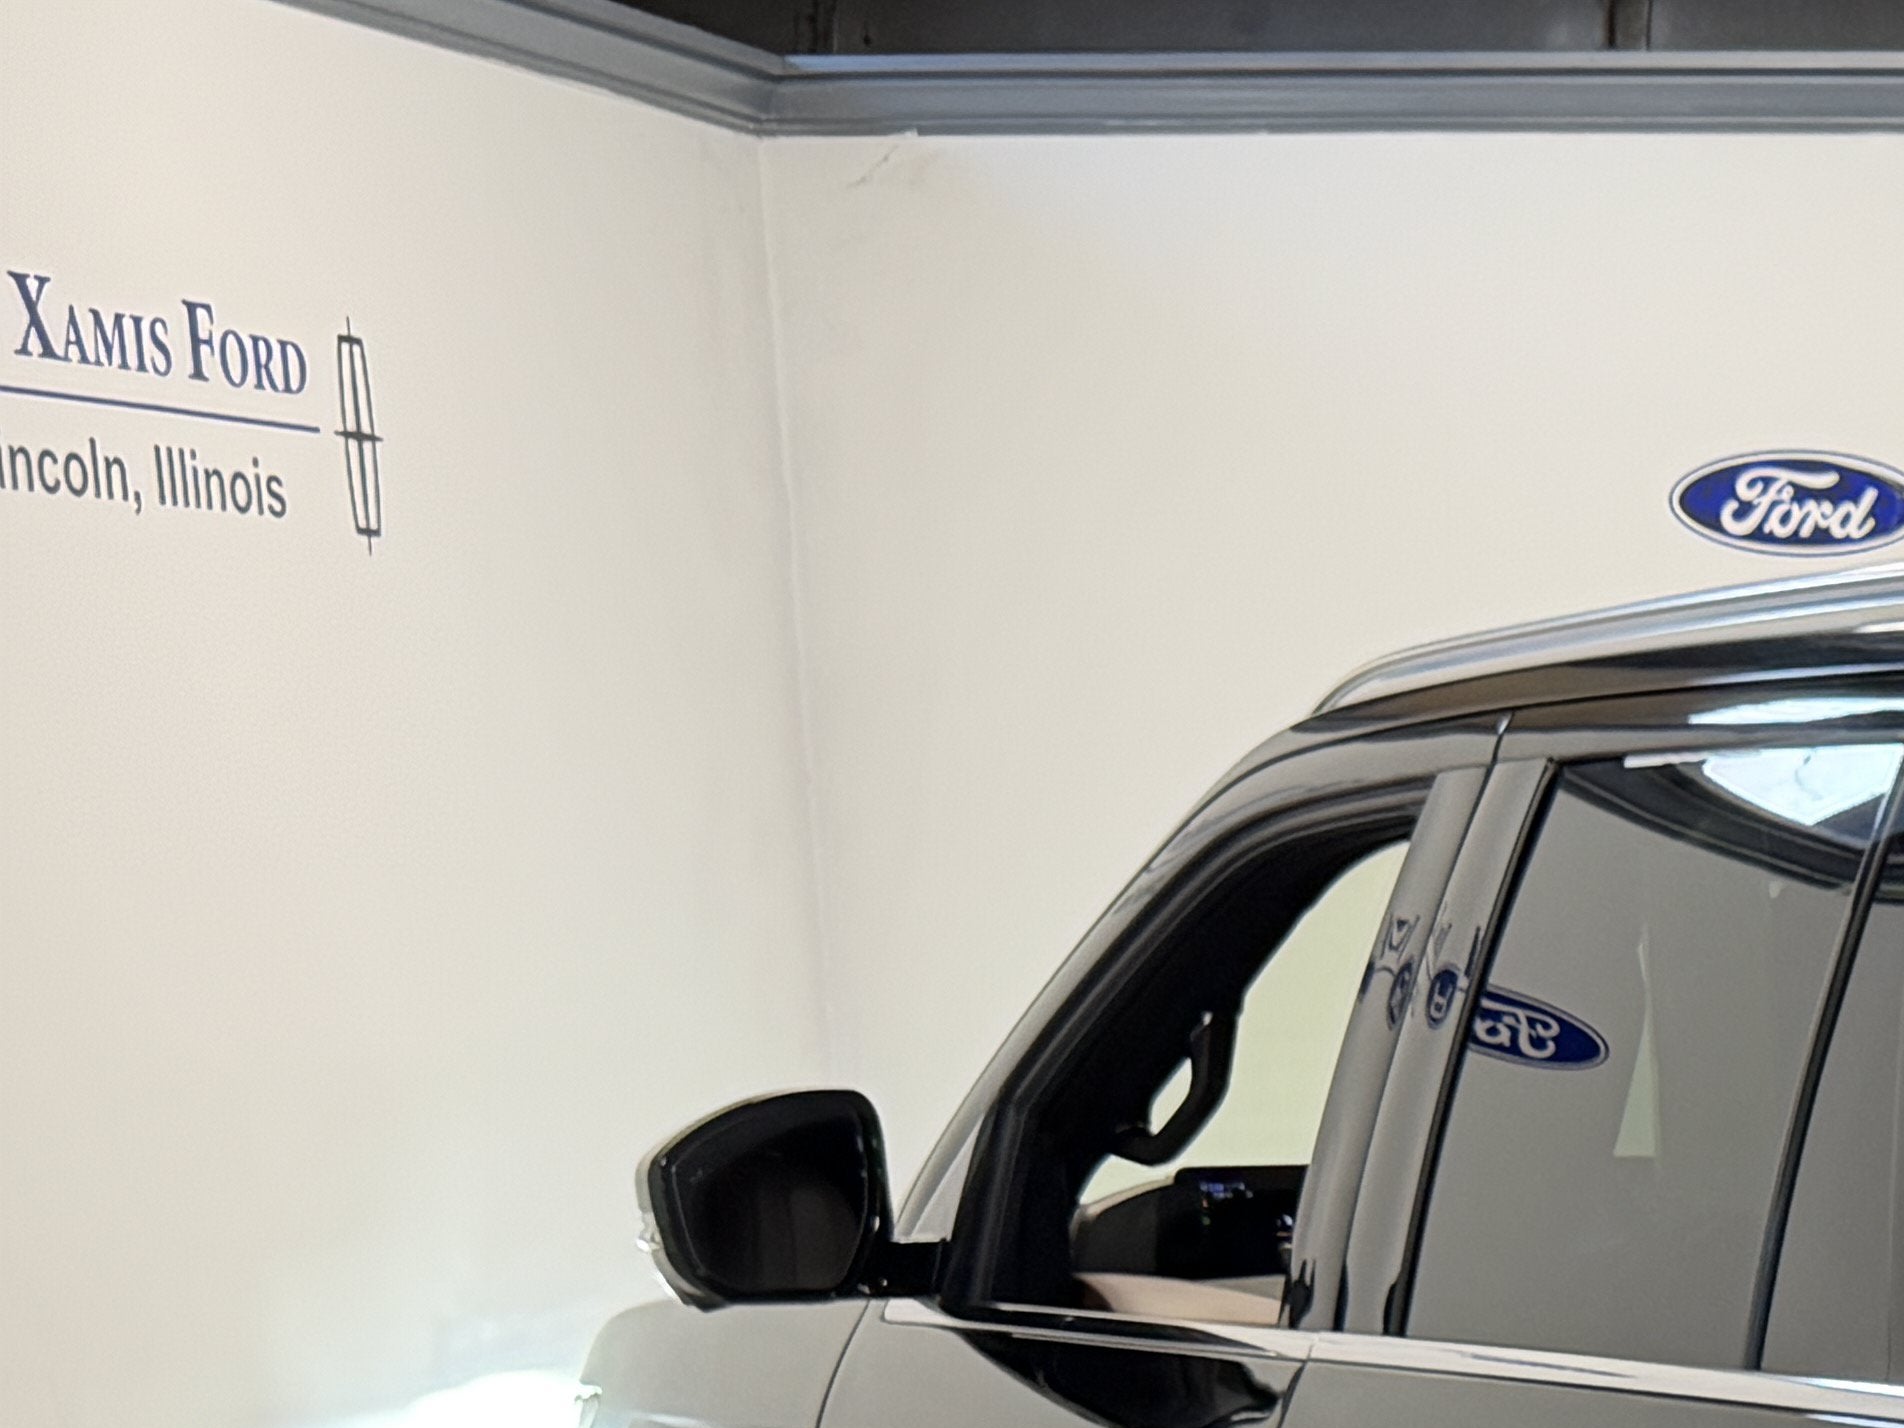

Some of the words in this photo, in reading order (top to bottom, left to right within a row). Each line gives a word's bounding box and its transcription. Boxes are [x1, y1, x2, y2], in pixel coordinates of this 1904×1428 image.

[6, 270, 173, 377] XAMIS
[180, 298, 307, 395] FORD
[0, 436, 142, 516] ncoln,
[153, 444, 287, 519] Illinois
[1720, 466, 1879, 540] Ford
